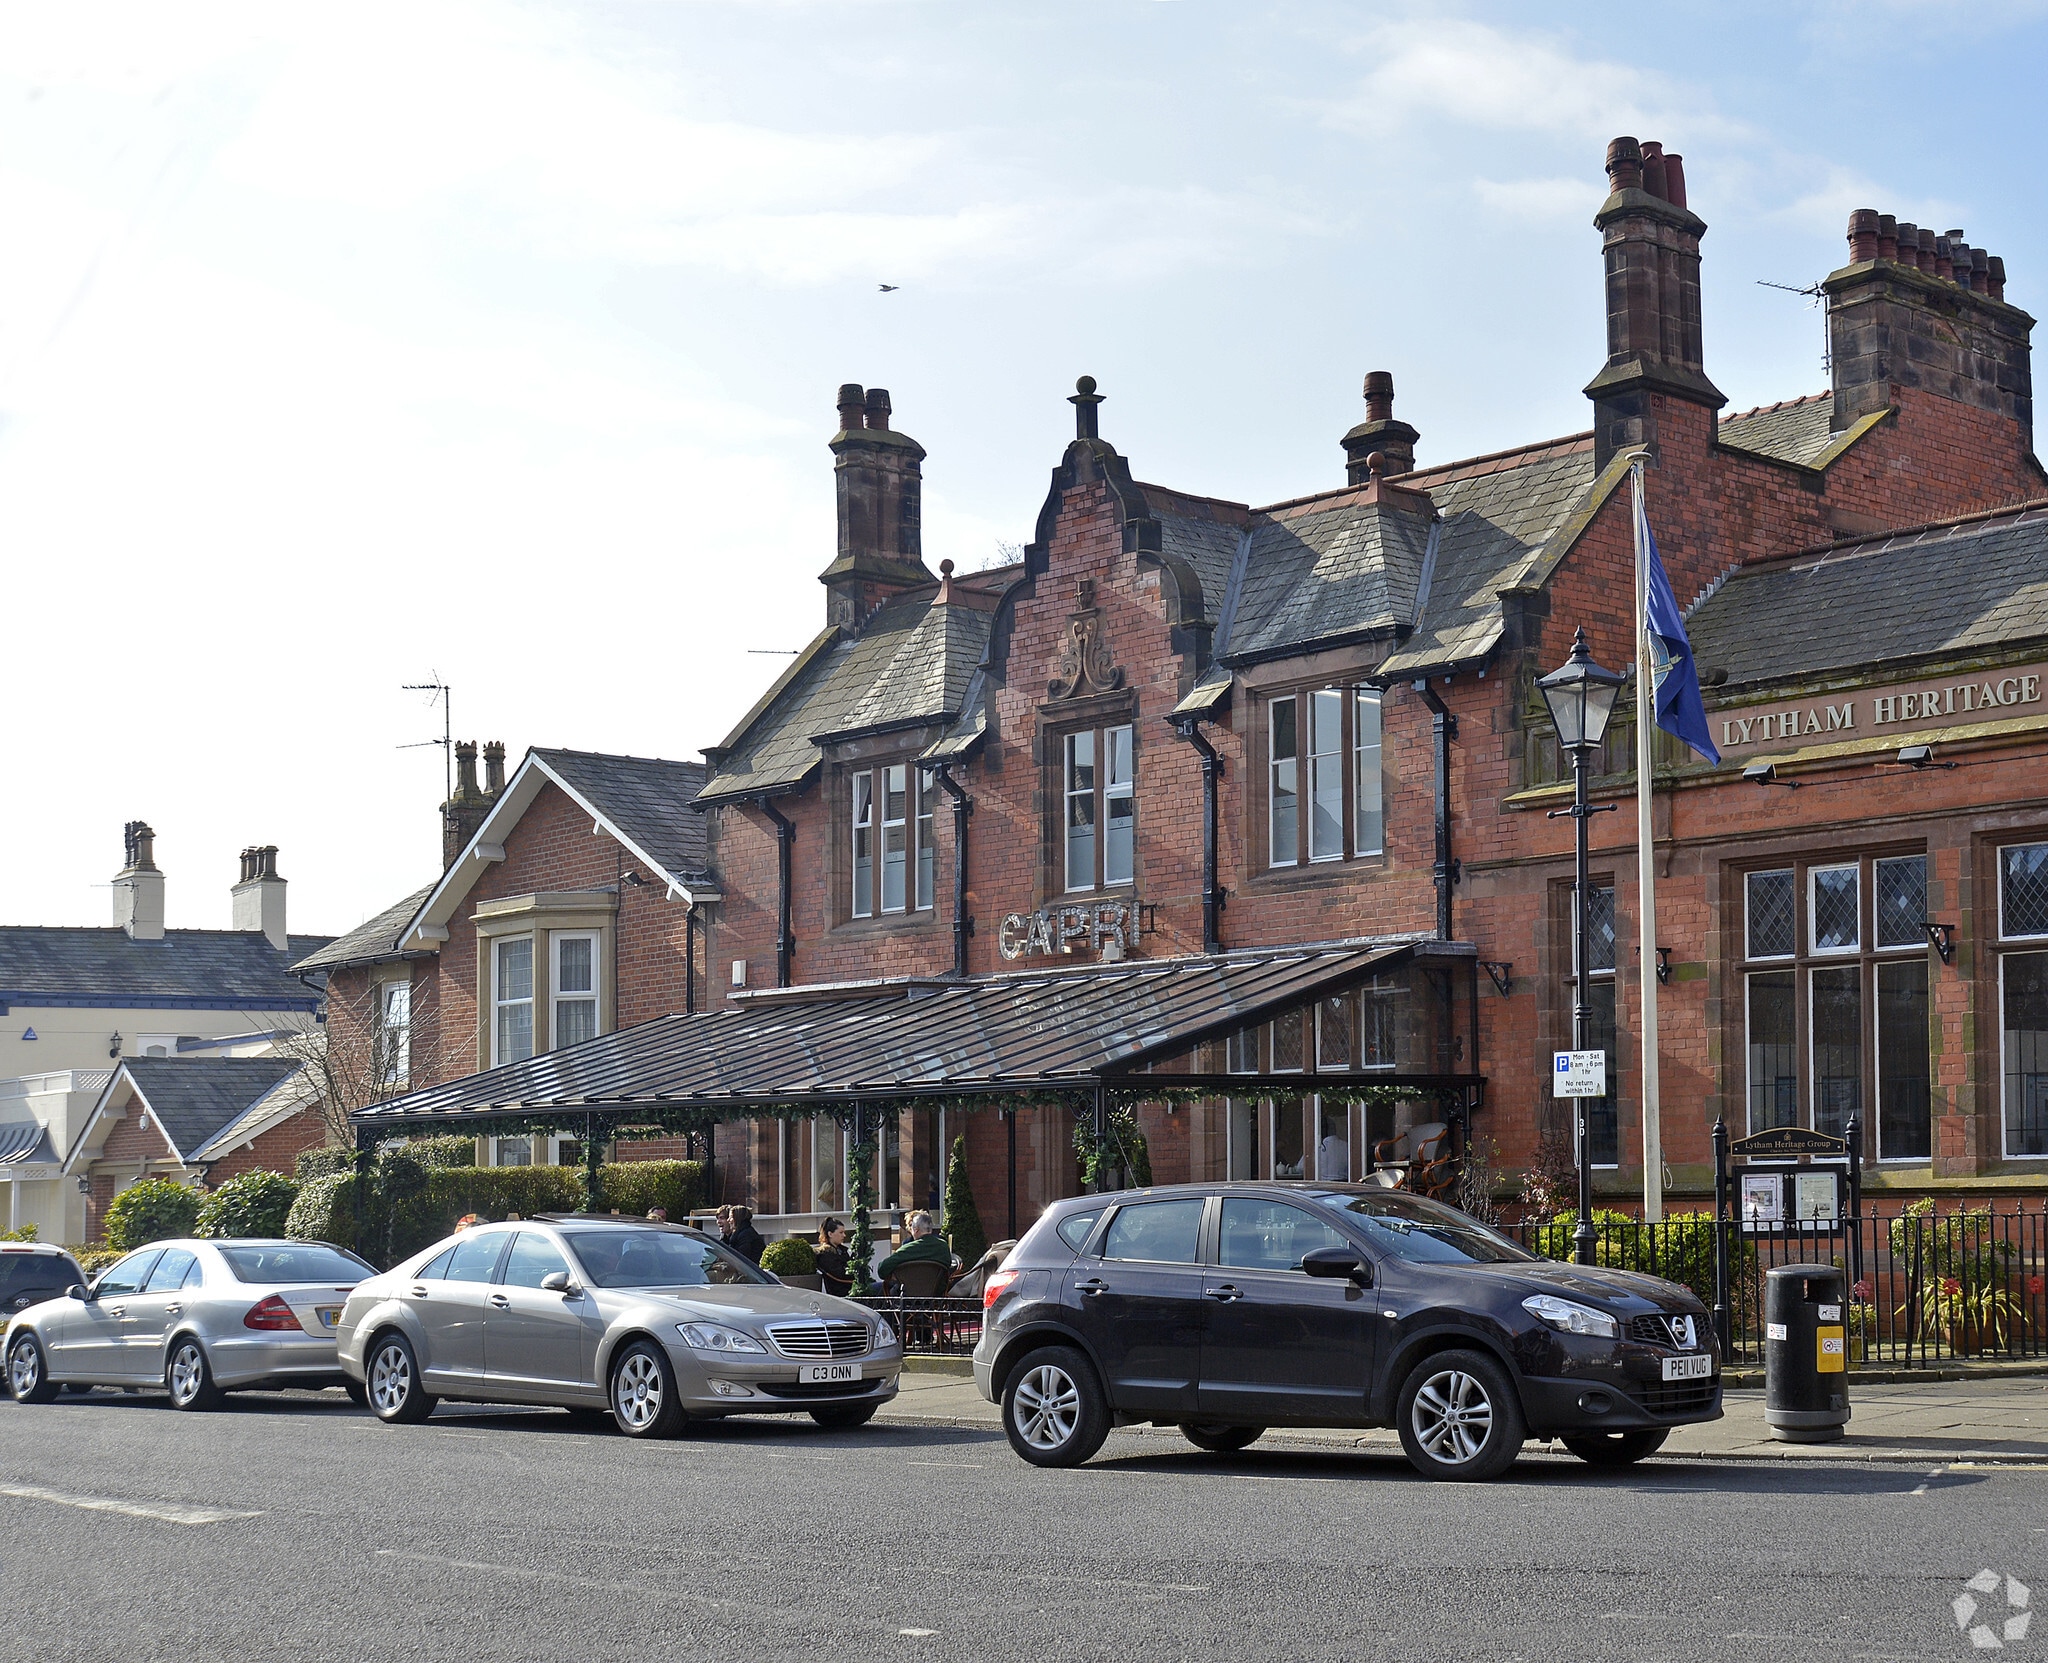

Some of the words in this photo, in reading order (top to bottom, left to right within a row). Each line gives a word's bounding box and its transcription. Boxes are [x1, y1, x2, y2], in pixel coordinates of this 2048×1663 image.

[1722, 702, 1854, 746] LYTHAM
[1873, 674, 2041, 725] HERITAGE
[999, 899, 1144, 961] CAPRI
[1745, 1141, 1773, 1149] Lytham
[1775, 1140, 1806, 1148] Heritage
[1807, 1140, 1831, 1148] Group
[812, 1367, 828, 1380] C3
[831, 1365, 852, 1379] ONN
